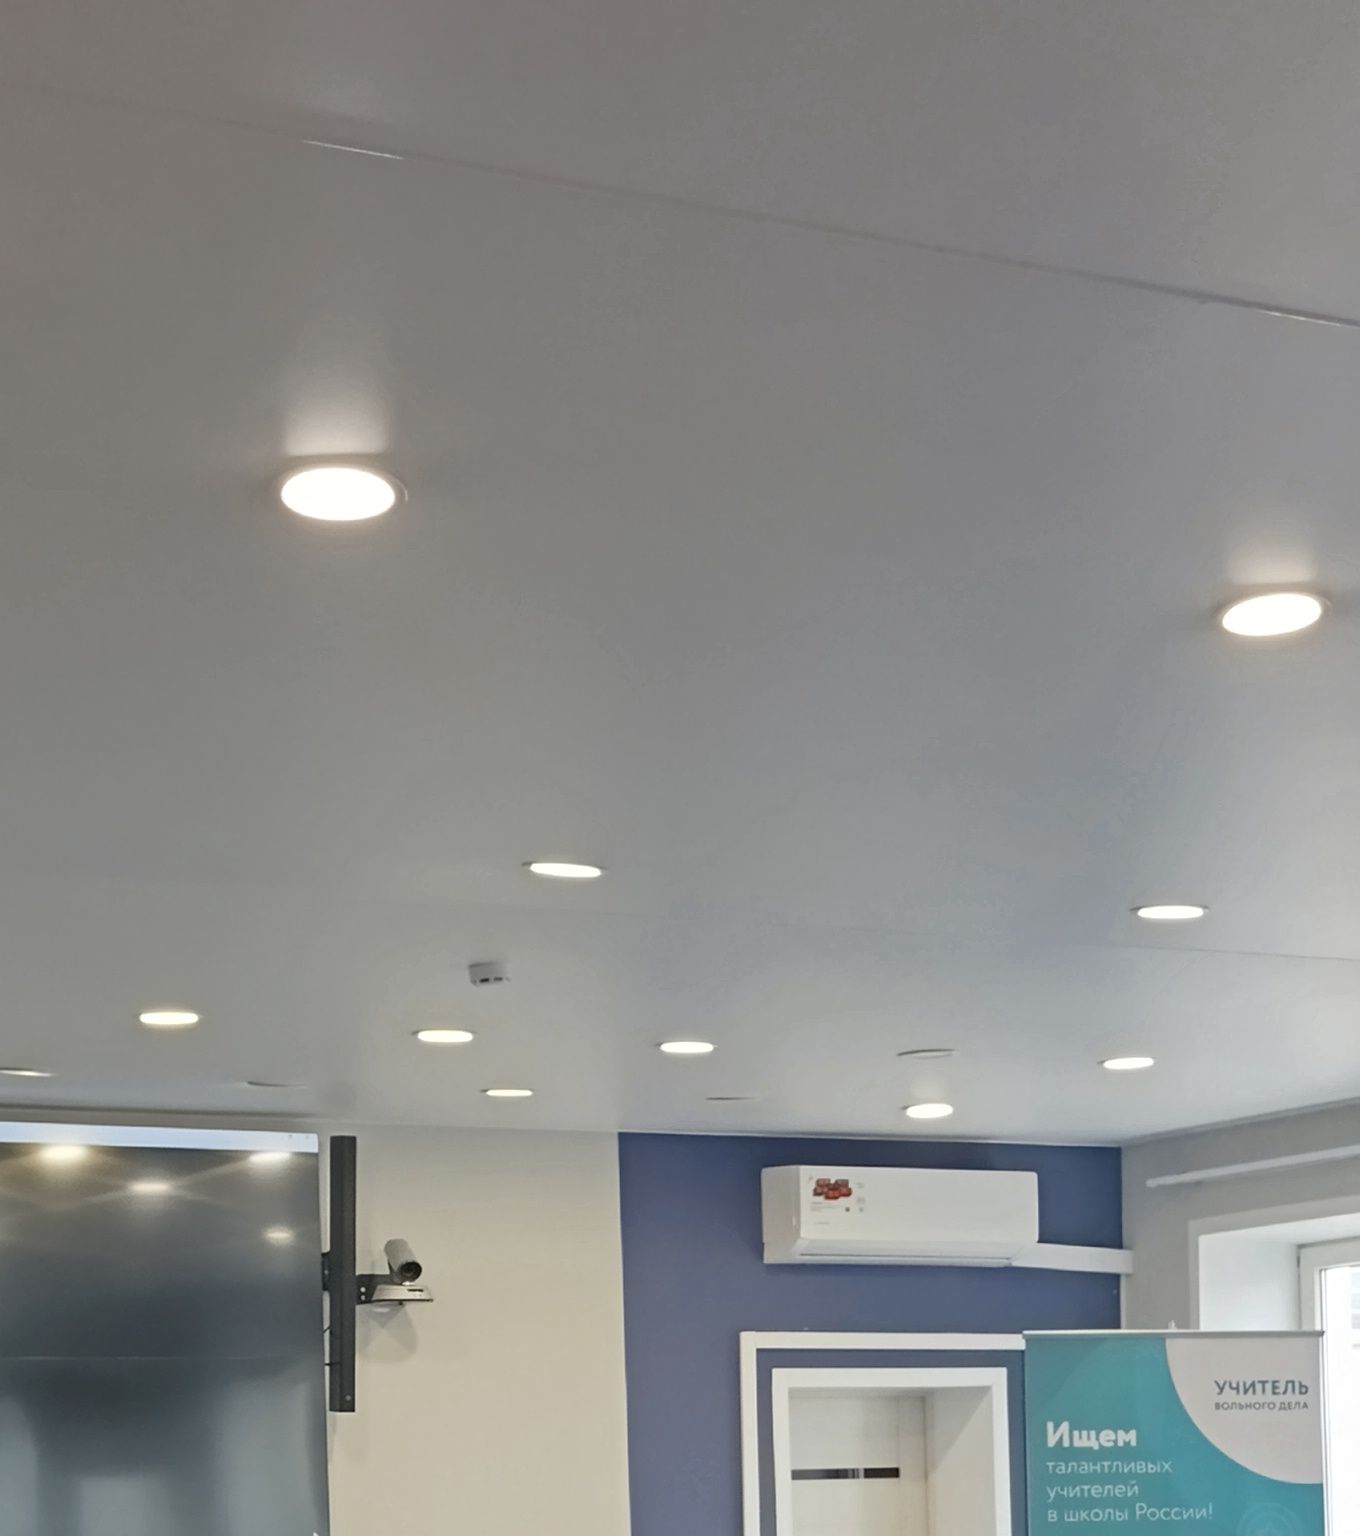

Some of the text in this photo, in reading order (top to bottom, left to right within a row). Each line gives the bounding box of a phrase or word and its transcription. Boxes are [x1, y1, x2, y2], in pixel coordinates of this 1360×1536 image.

[1214, 1380, 1309, 1396] УЧИТЕЛЬ
[1214, 1401, 1309, 1411] ВОЛЬНОГО ДЕЛА
[1046, 1421, 1136, 1450] Ищем
[1046, 1459, 1172, 1474] талантливых
[1046, 1481, 1139, 1502] учителей
[1047, 1502, 1213, 1522] в школы России!
